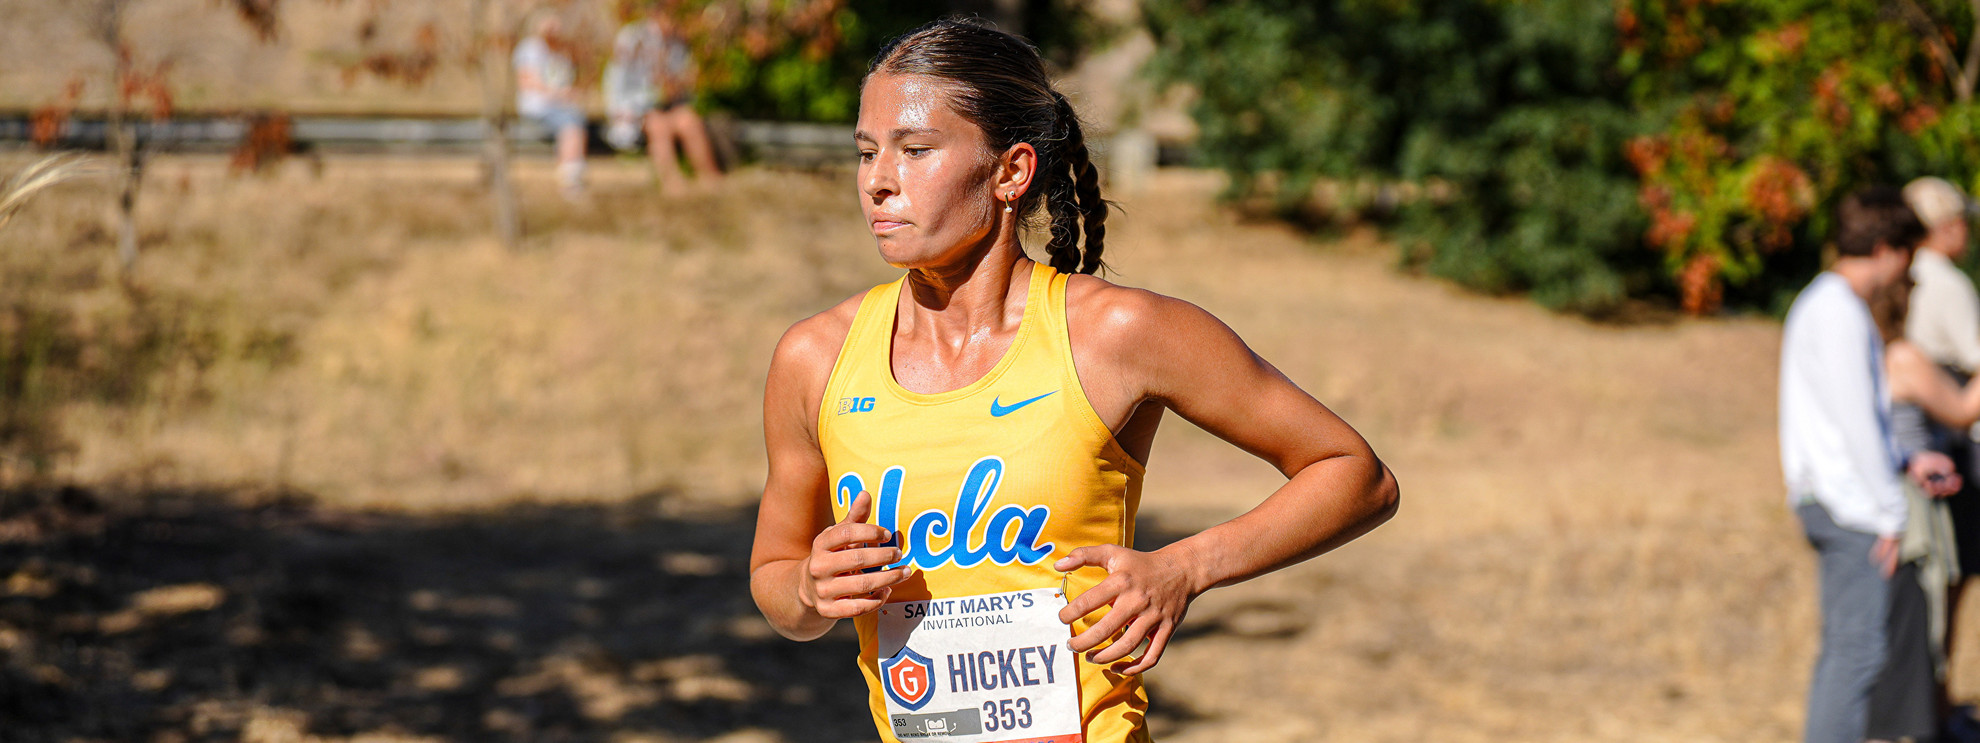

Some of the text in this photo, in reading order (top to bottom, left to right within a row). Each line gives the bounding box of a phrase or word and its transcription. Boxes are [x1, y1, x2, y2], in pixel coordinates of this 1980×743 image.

[904, 593, 1034, 618] SAINT MARY'S
[923, 614, 1013, 630] INVITATIONAL
[899, 666, 919, 696] G
[947, 644, 1057, 693] HICKEY
[893, 718, 907, 727] 353
[983, 697, 1032, 732] 353
